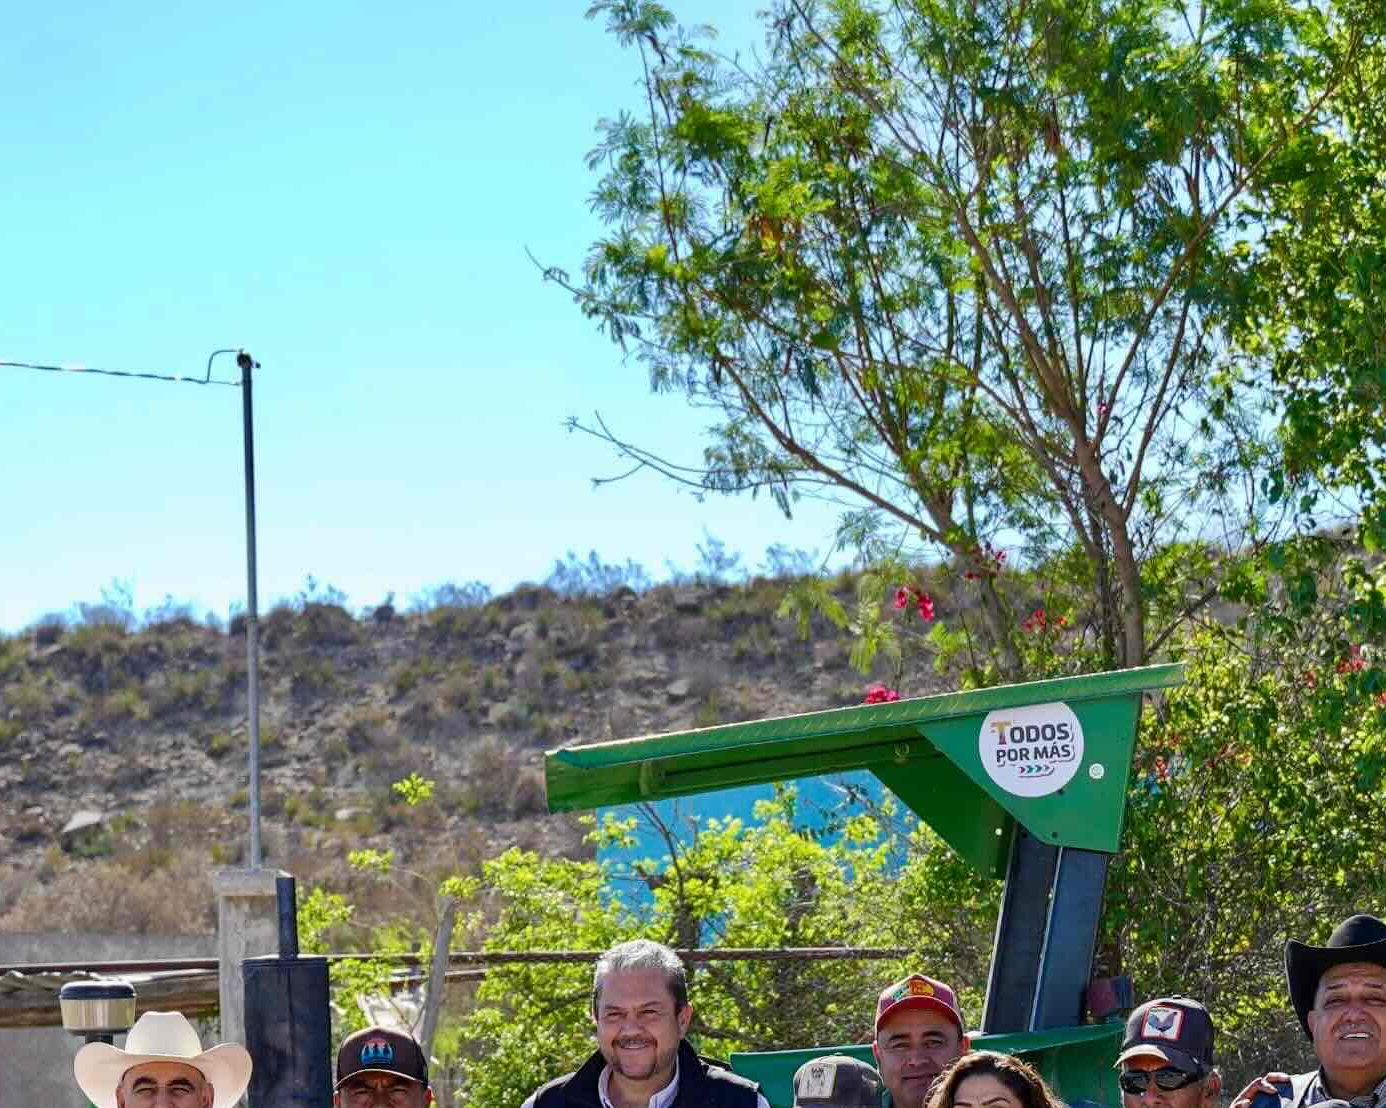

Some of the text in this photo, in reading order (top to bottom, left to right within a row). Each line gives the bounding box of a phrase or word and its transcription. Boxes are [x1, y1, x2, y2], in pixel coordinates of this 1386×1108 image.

[990, 721, 1070, 745] TODOS
[996, 741, 1071, 763] POR MÁS
